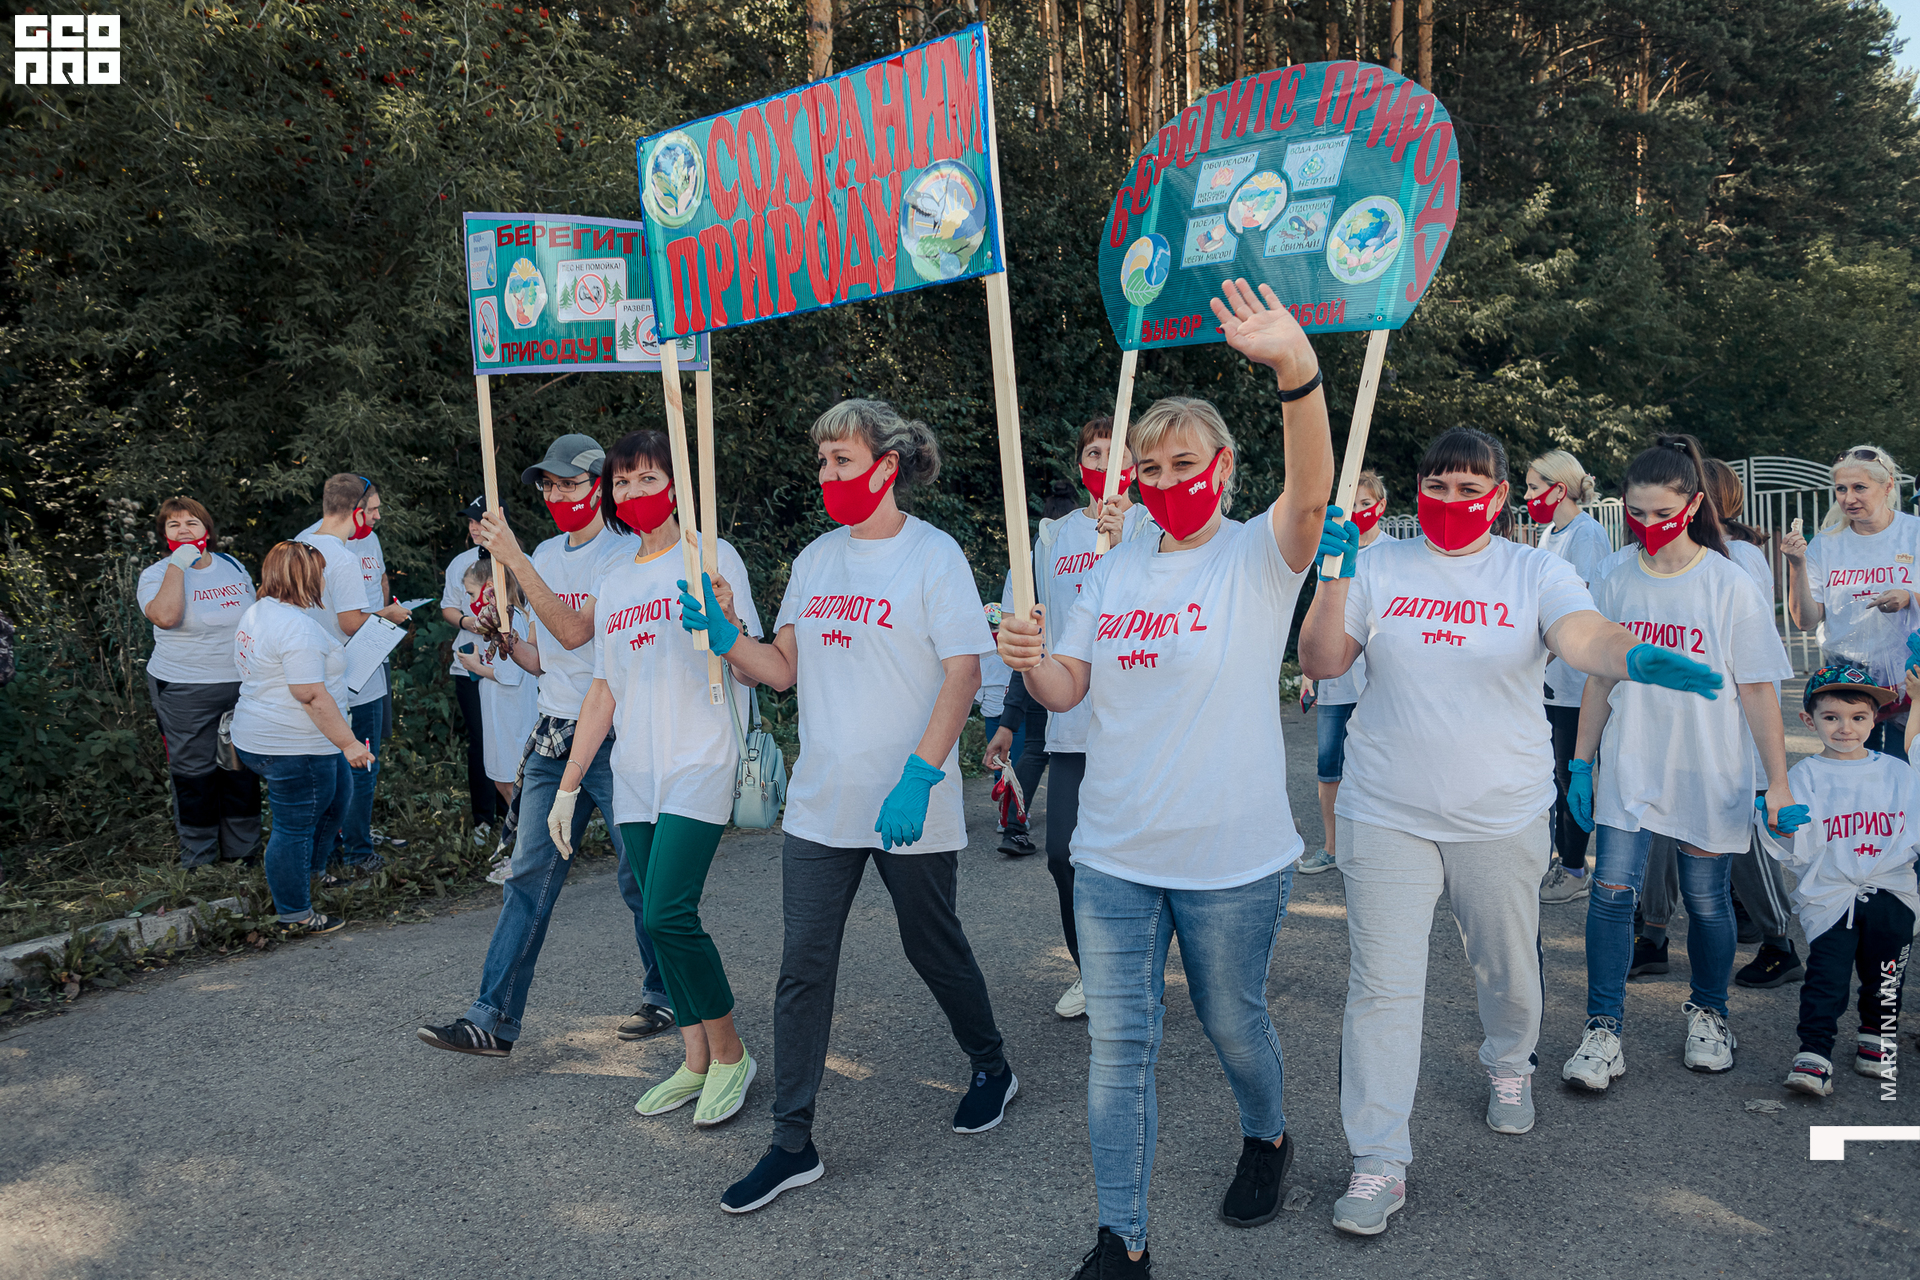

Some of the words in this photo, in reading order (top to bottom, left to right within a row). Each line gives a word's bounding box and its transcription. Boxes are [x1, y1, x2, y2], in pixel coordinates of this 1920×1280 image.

[706, 34, 985, 221] СОХРАНИМ
[1110, 63, 1307, 248] БЕРЕГИТЕ
[1313, 60, 1460, 302] ПРИРОДУ
[496, 223, 646, 257] БЕРЕГИТ
[666, 171, 902, 335] ПРИРОДУ
[1268, 245, 1277, 253] НЕ
[576, 263, 585, 271] НЕ
[586, 261, 621, 271] ПОМОЙКА!
[1141, 314, 1202, 343] ВЫБОР
[1284, 298, 1346, 327] ОБОЙ
[501, 336, 613, 364] ПРИРОДУ!
[1052, 552, 1104, 579] ПАТРИ
[1825, 566, 1894, 588] ПАТРИОТ
[1898, 566, 1913, 584] 2
[193, 584, 243, 602] ПАТРИОТ
[605, 598, 672, 635] ПАТРИОТ
[798, 595, 876, 626] ПАТРИОТ
[877, 598, 893, 630] 2
[1187, 602, 1208, 633] 2
[1381, 596, 1488, 627] ПАТРИОТ
[1493, 602, 1515, 628] 2
[1619, 621, 1686, 651] ТРИОТ
[1690, 628, 1706, 654] 2
